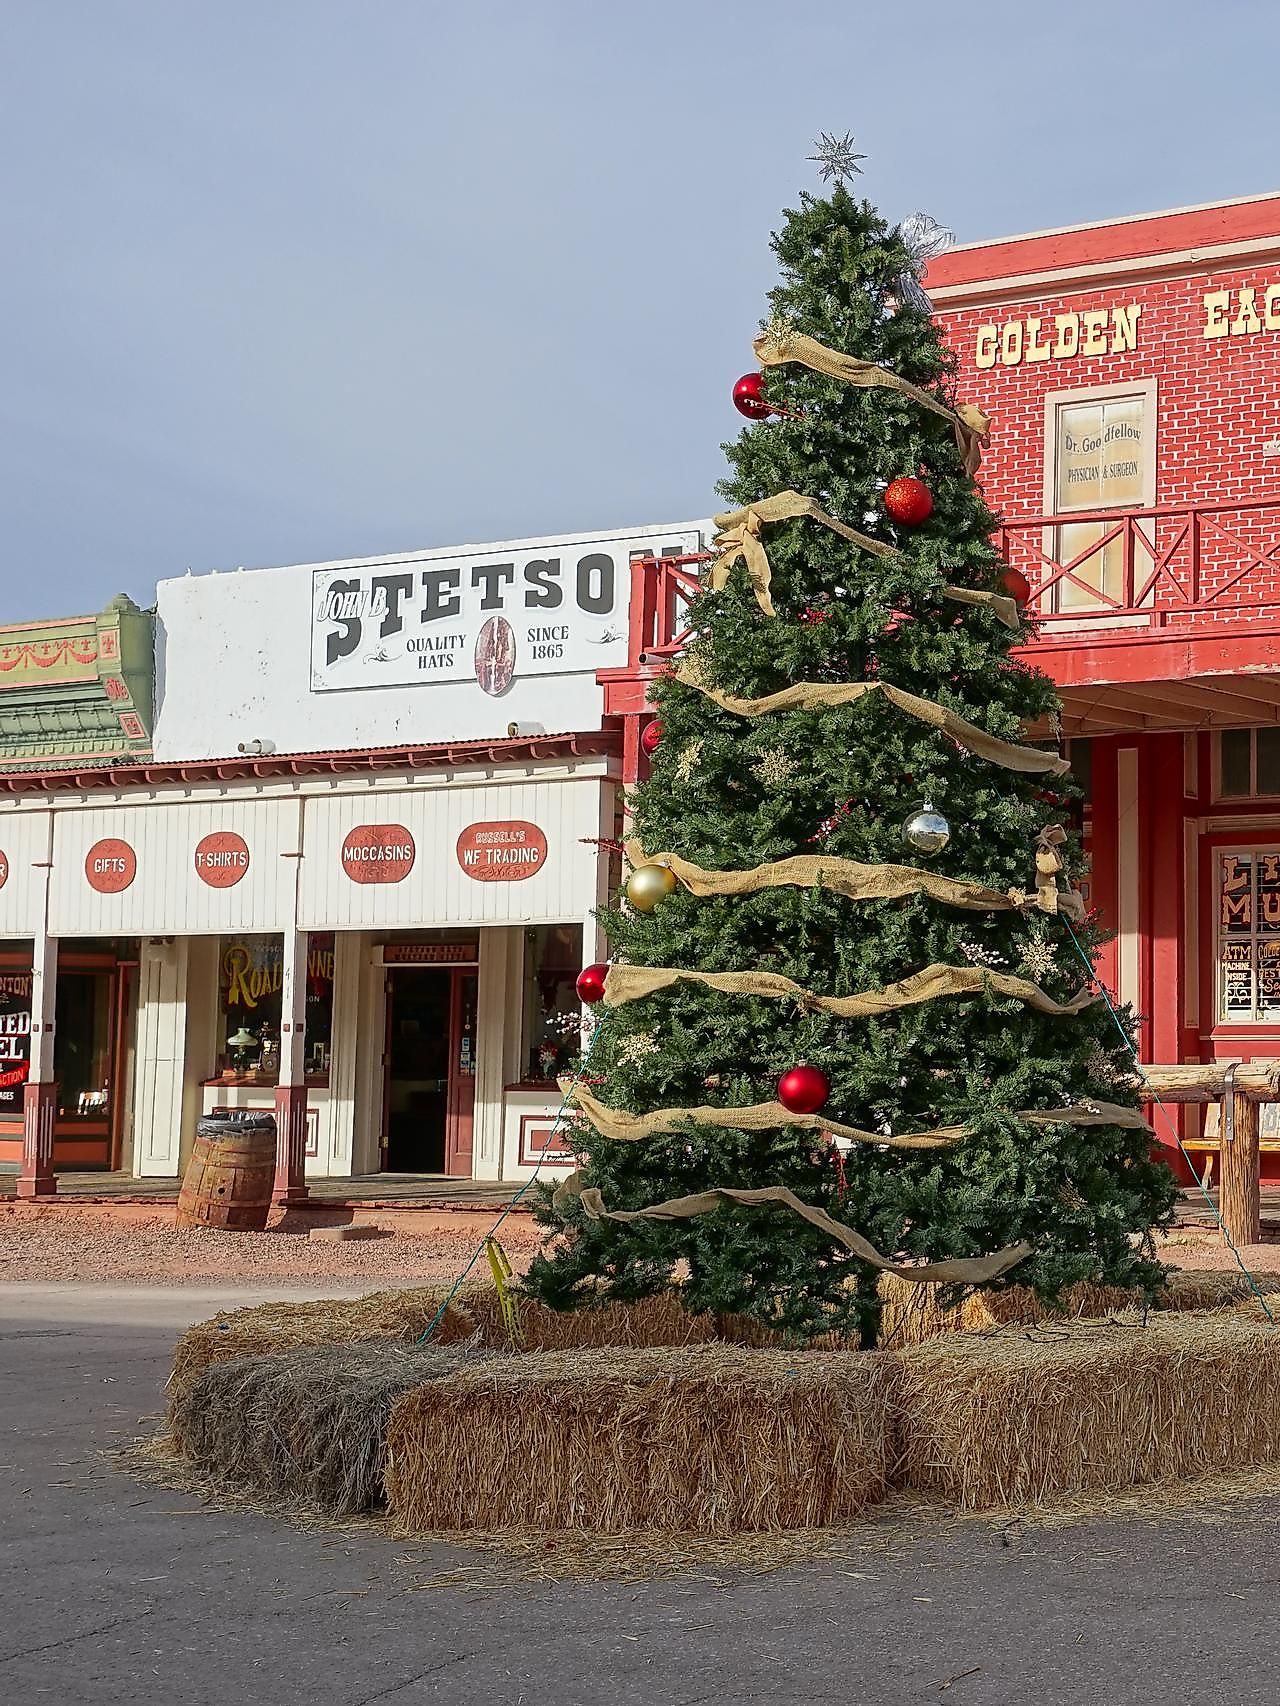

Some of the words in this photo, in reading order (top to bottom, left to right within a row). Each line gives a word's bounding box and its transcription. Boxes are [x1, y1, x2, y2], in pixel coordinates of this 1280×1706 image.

[974, 305, 1143, 369] GOLDEN
[1065, 435, 1080, 453] Dr.
[1082, 423, 1142, 453] Goodfellow
[1068, 465, 1100, 483] PHYSICIAN
[1109, 461, 1138, 479] SURGEON
[317, 590, 369, 622] JOHN
[527, 625, 569, 643] SINCE
[406, 633, 467, 654] QUALITY
[417, 652, 455, 670] HATS
[531, 646, 564, 661] 1865
[196, 851, 247, 868] T-SHIRTS
[343, 845, 412, 862] MOCCASINS
[486, 847, 539, 865] TRADING
[94, 858, 126, 873] GIFTS
[1222, 945, 1252, 960] ATM
[1221, 961, 1250, 971] MACHINE
